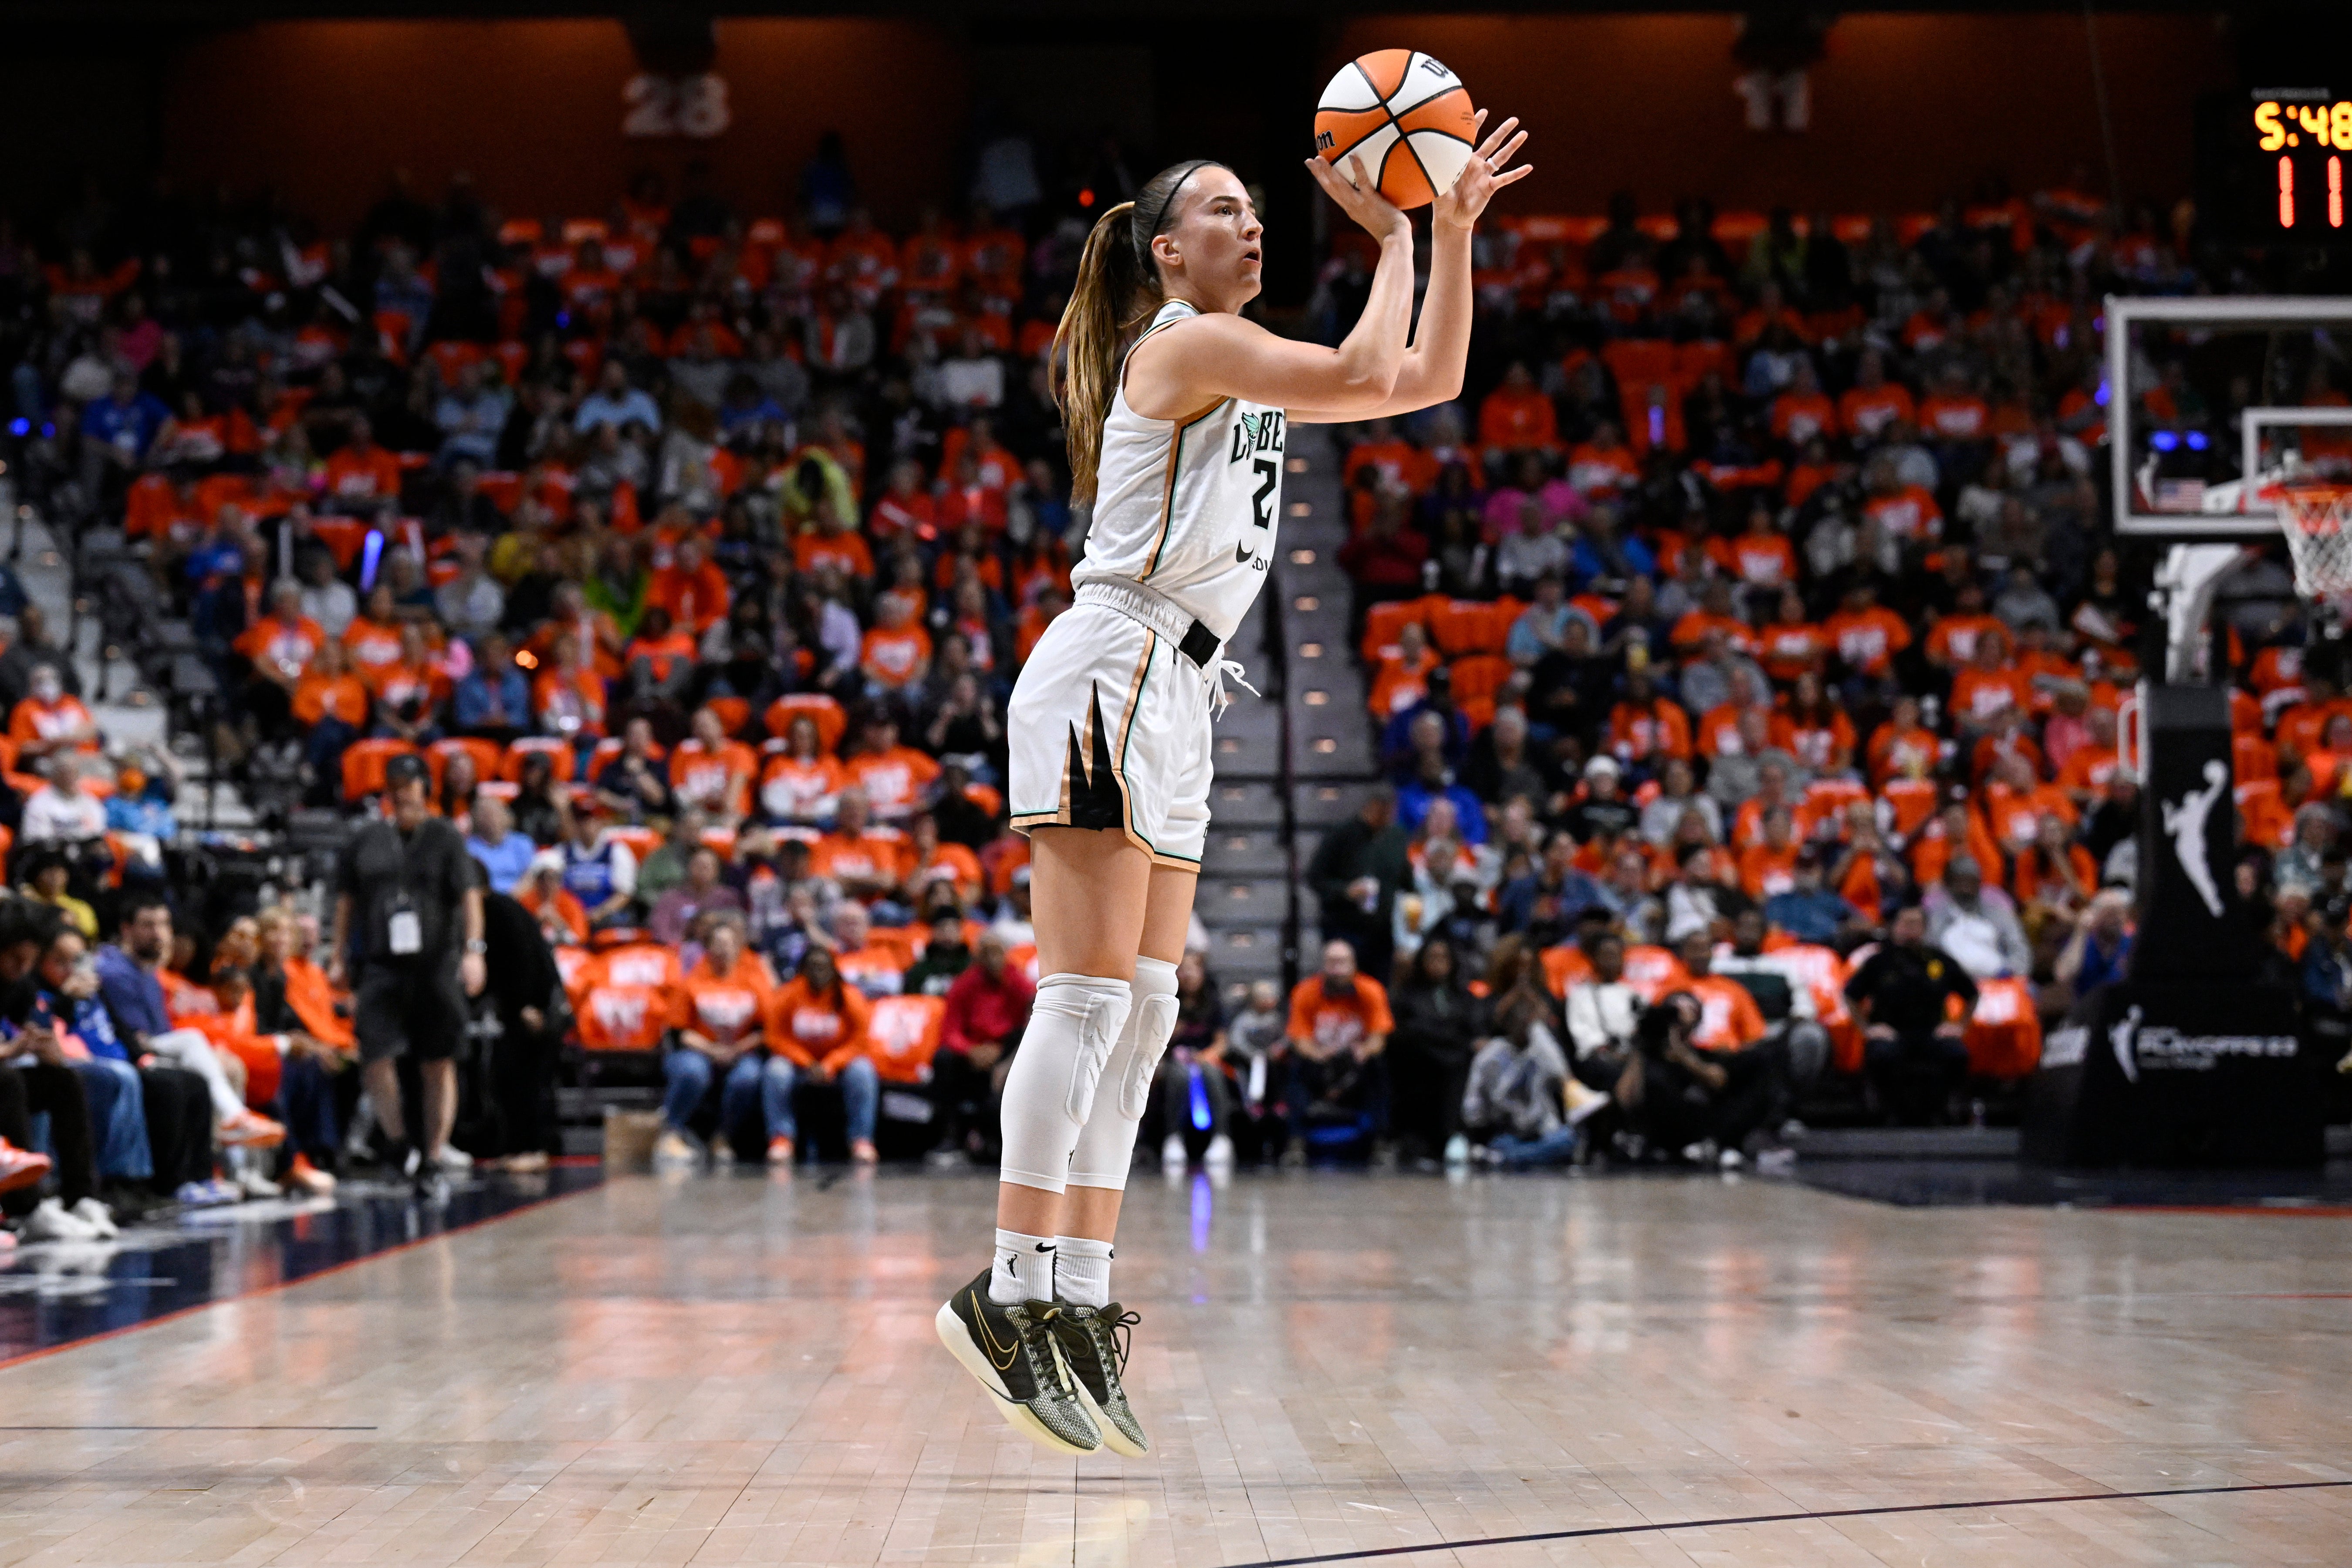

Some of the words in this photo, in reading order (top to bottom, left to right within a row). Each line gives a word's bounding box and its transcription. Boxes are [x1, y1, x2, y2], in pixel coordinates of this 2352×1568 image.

[2254, 101, 2352, 151] 5:48
[2279, 155, 2343, 228] 11
[1230, 410, 1286, 464] LIBE
[1252, 457, 1277, 530] 2
